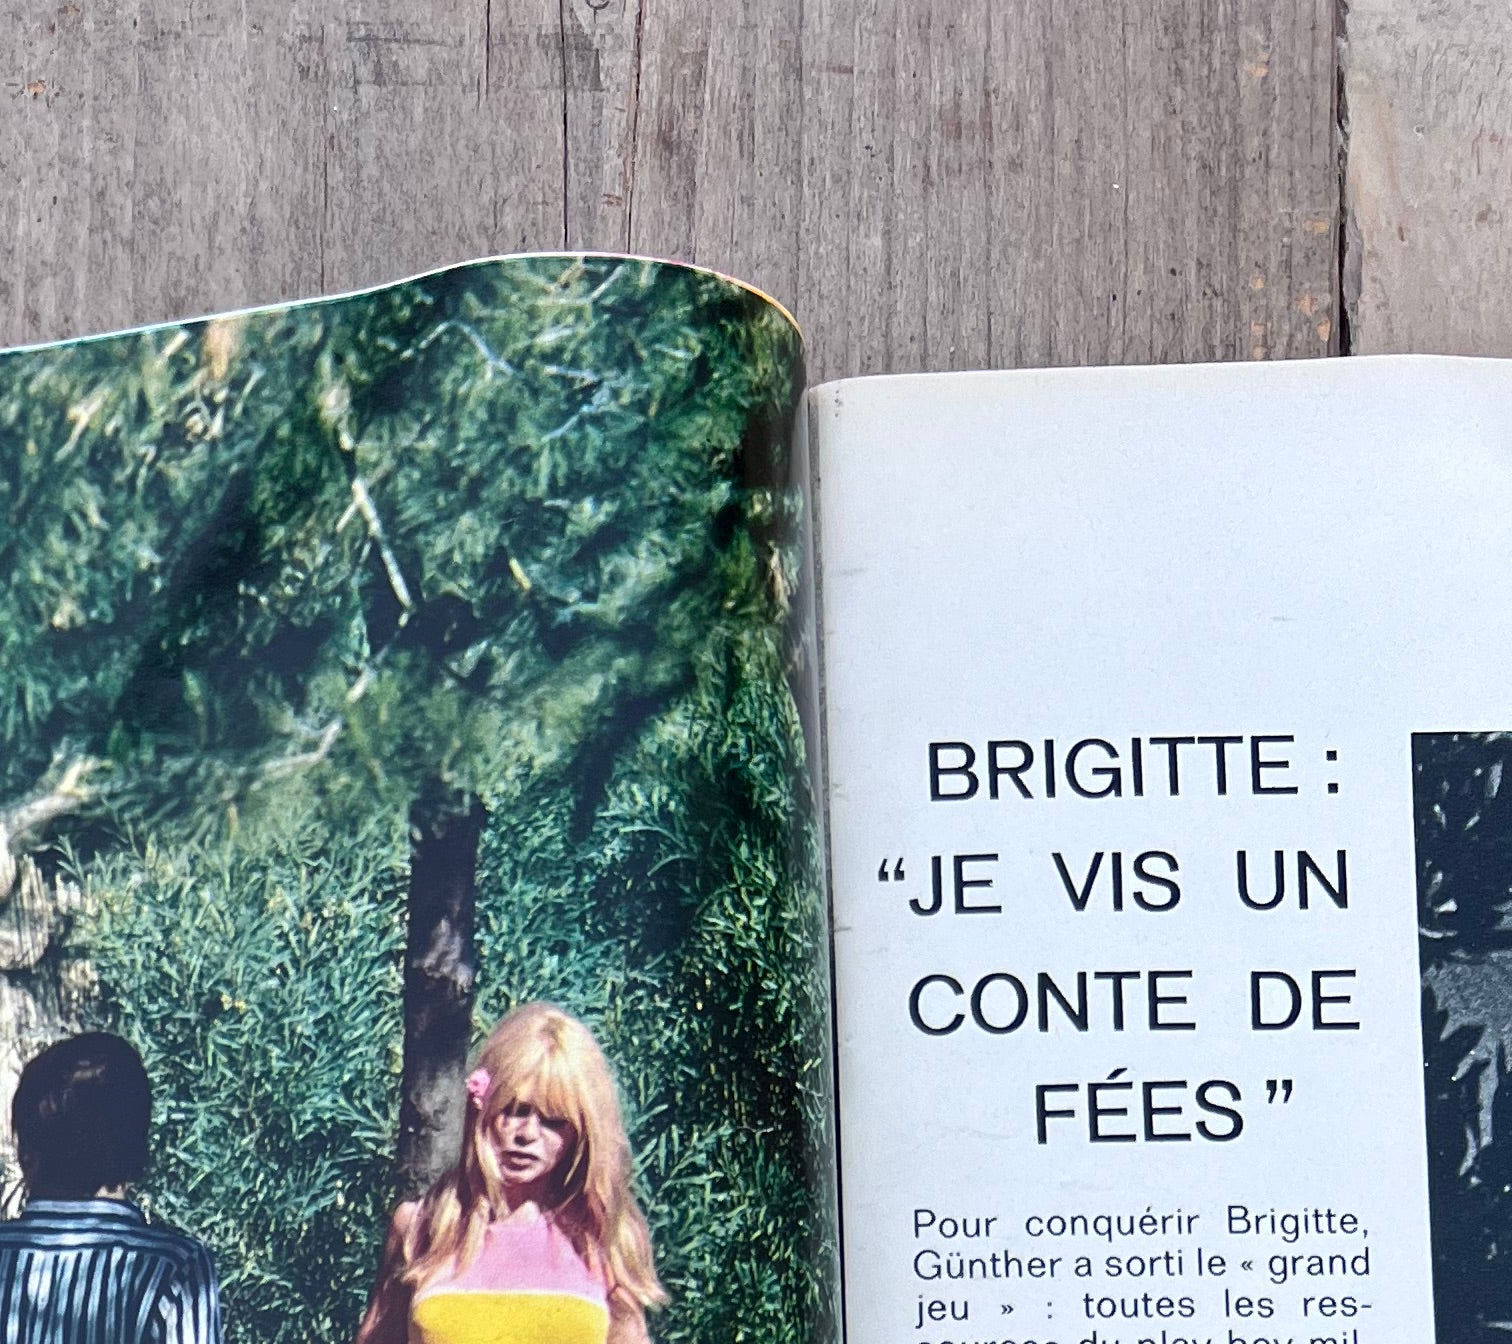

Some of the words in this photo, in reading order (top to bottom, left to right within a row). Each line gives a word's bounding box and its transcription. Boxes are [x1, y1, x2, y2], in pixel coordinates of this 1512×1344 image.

[1050, 849, 1182, 913] VIS
[1236, 848, 1349, 912] UN
[908, 969, 1197, 1037] CONTE
[1250, 968, 1361, 1032] DE
[913, 1208, 998, 1239] Pour
[1024, 1205, 1201, 1244] conquérir
[1227, 1204, 1369, 1244] Brigitte,
[913, 1248, 1063, 1281] Günther
[1073, 1255, 1093, 1278] a
[1104, 1248, 1184, 1278] sorti
[1197, 1246, 1227, 1277] le
[1267, 1245, 1370, 1285] grand
[914, 1294, 969, 1330] jeu
[1082, 1291, 1196, 1320] toutes
[1224, 1287, 1275, 1319] les
[1302, 1295, 1373, 1318] res-
